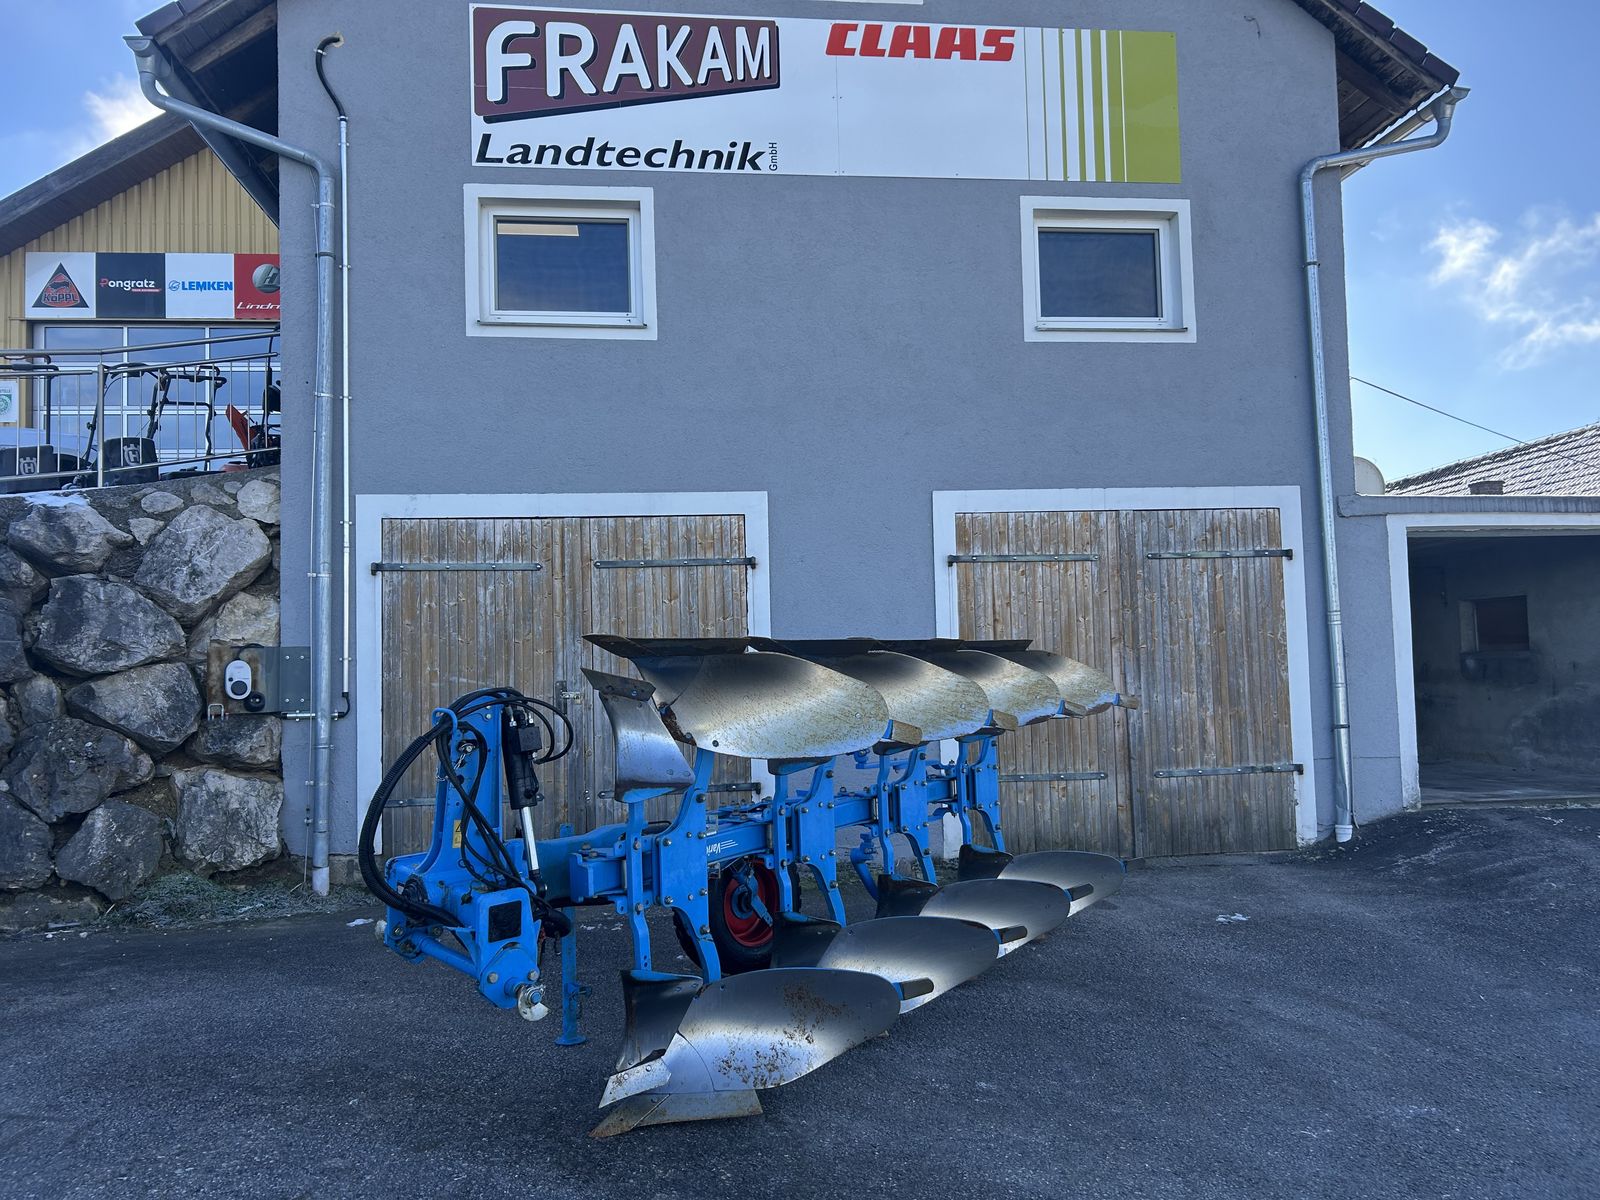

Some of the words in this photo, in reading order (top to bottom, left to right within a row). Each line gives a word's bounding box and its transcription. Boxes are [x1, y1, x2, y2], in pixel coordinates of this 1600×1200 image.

[825, 22, 1016, 62] CLAAS
[486, 20, 771, 103] FRAKAM
[476, 133, 766, 171] Landtechnik
[768, 142, 778, 171] GmbH
[100, 278, 155, 291] Pongratz
[181, 281, 234, 291] LEMKEN
